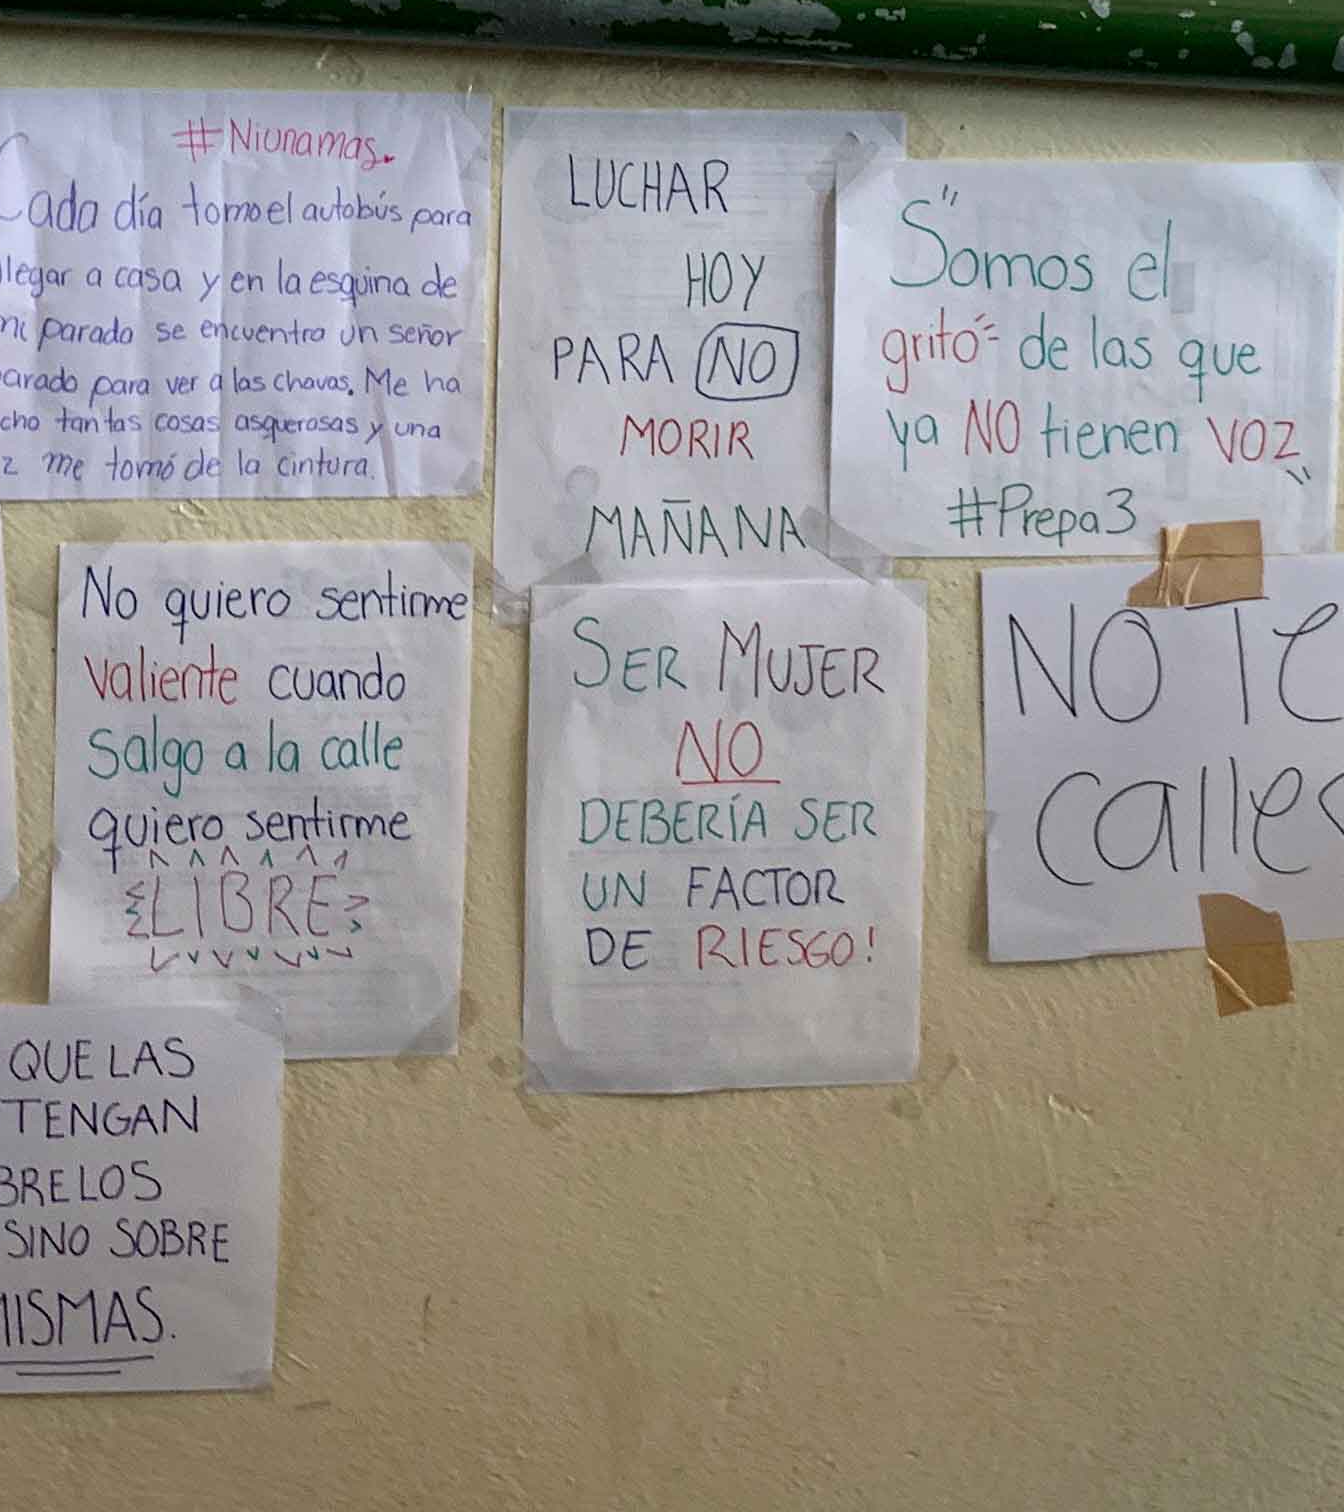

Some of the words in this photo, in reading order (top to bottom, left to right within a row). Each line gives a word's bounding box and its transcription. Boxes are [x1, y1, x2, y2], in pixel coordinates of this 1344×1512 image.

[567, 156, 730, 217] LUCHAR
[684, 250, 767, 313] HOY
[618, 410, 754, 463] MORIR
[946, 485, 1136, 547] #Prepa3
[572, 616, 687, 693] SER
[719, 620, 885, 698] MUJER
[583, 870, 647, 911] UN
[687, 866, 845, 911] FACTOR
[586, 927, 652, 970] DE
[696, 923, 875, 970] RIESGO!
[9, 1041, 95, 1088] QUE
[110, 1036, 196, 1079] LAS
[1, 1094, 199, 1139] TENGAN
